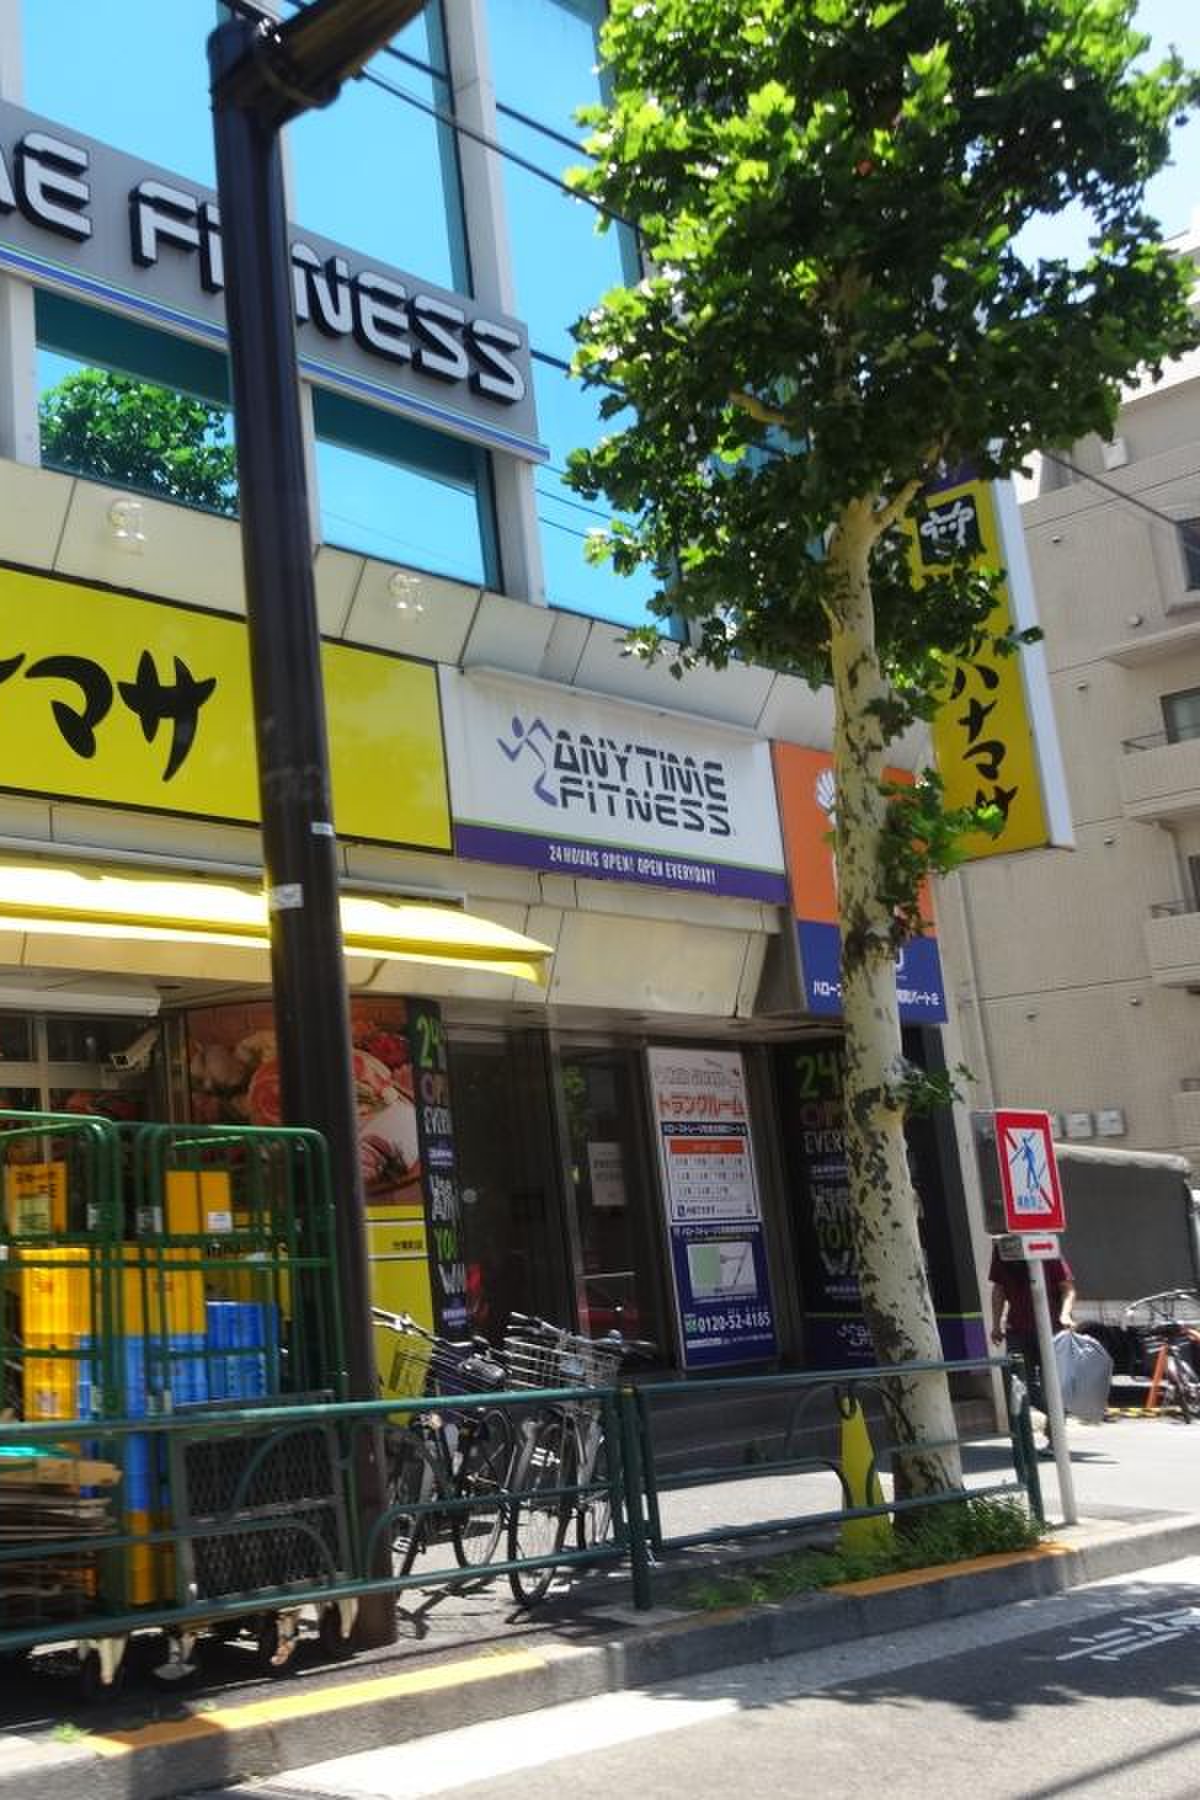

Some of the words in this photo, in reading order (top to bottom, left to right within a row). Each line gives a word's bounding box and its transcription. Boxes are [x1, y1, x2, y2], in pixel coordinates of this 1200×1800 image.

[129, 180, 527, 405] FINESS
[553, 729, 726, 802] ANYTIME
[559, 775, 732, 837] FITNESS
[601, 852, 634, 873] OPEN!
[637, 856, 664, 877] OPEN
[665, 861, 717, 885] EVERYDAY!
[657, 1092, 746, 1118] トランクルーム
